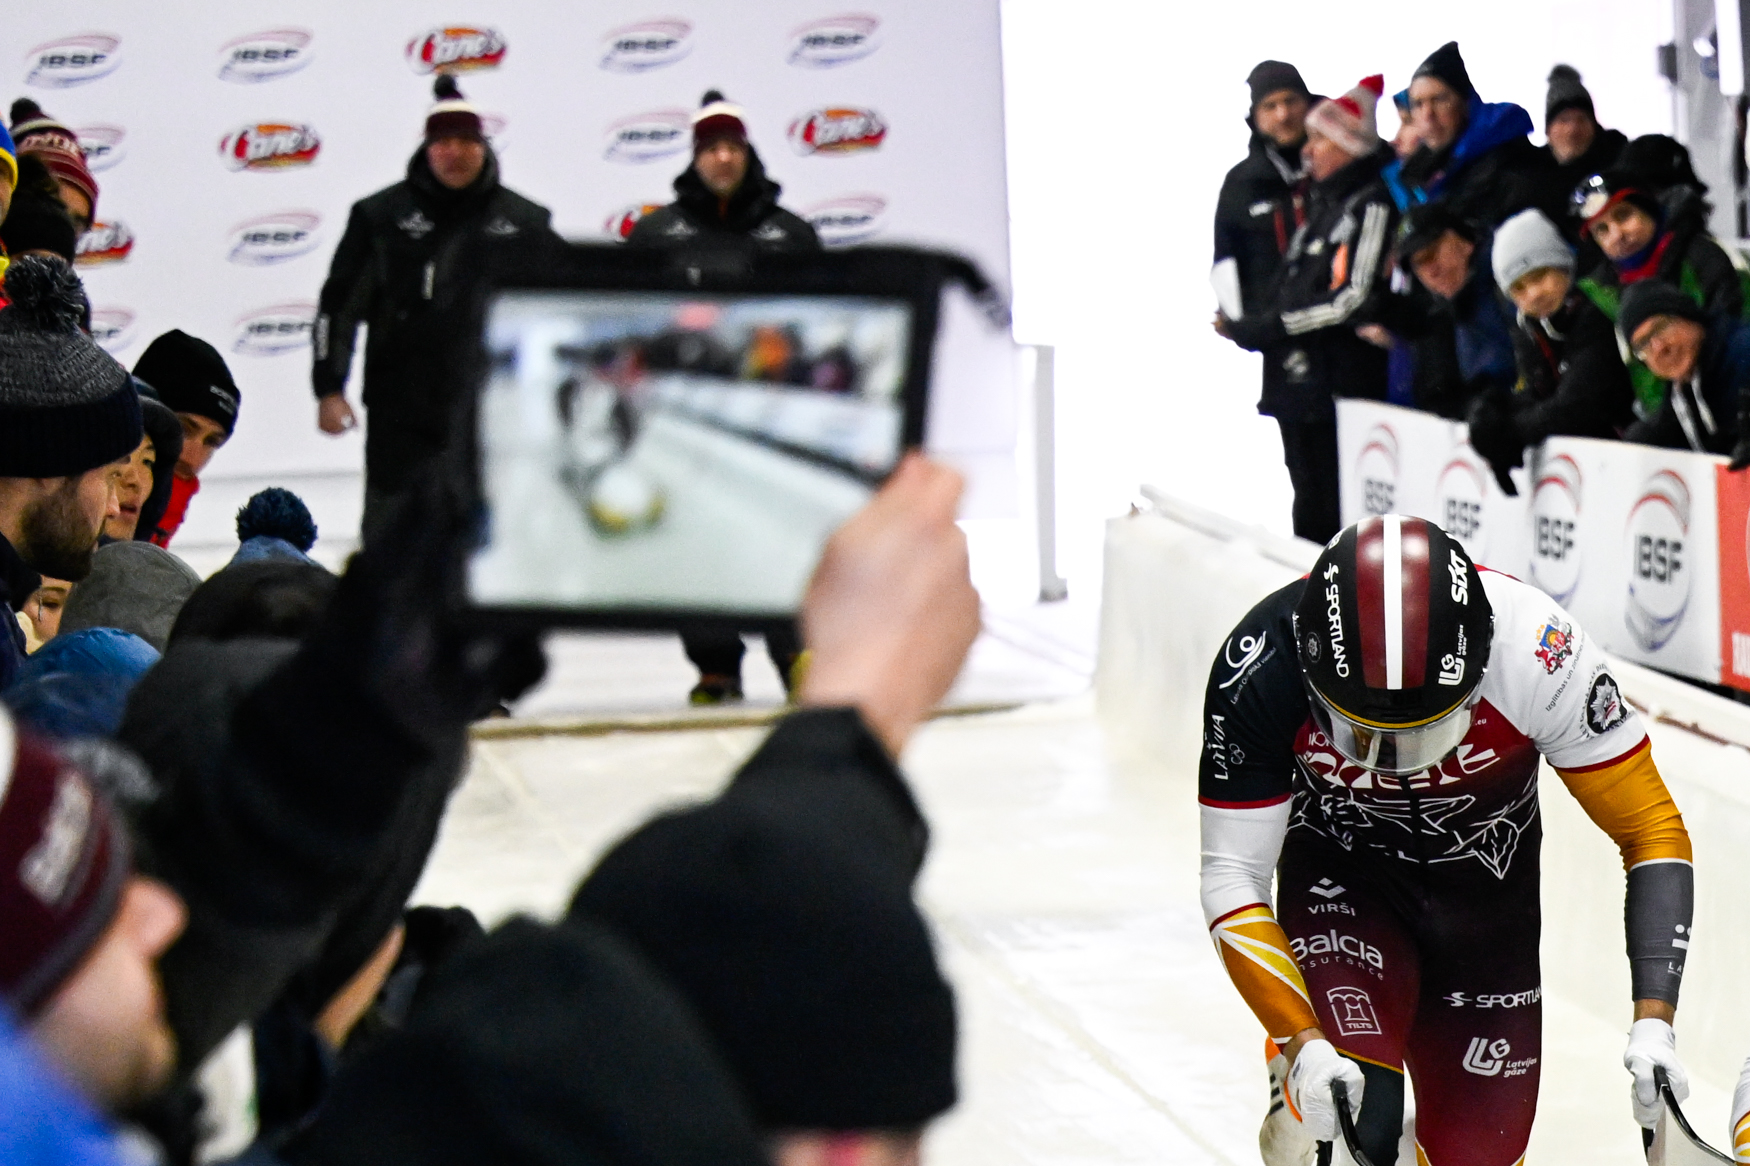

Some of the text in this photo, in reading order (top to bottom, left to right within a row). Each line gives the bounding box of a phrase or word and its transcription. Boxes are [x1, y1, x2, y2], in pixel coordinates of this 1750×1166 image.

[1534, 514, 1578, 562] IBSF
[1634, 533, 1684, 585] IBSF
[1325, 584, 1350, 679] SPORTLAND
[1566, 669, 1574, 681] un
[1211, 714, 1229, 781] LATVIJA
[1308, 902, 1357, 917] VIRŠI
[1289, 928, 1384, 970] Balcia
[1345, 1022, 1374, 1030] TILTS
[1505, 1057, 1538, 1068] Latvijas
